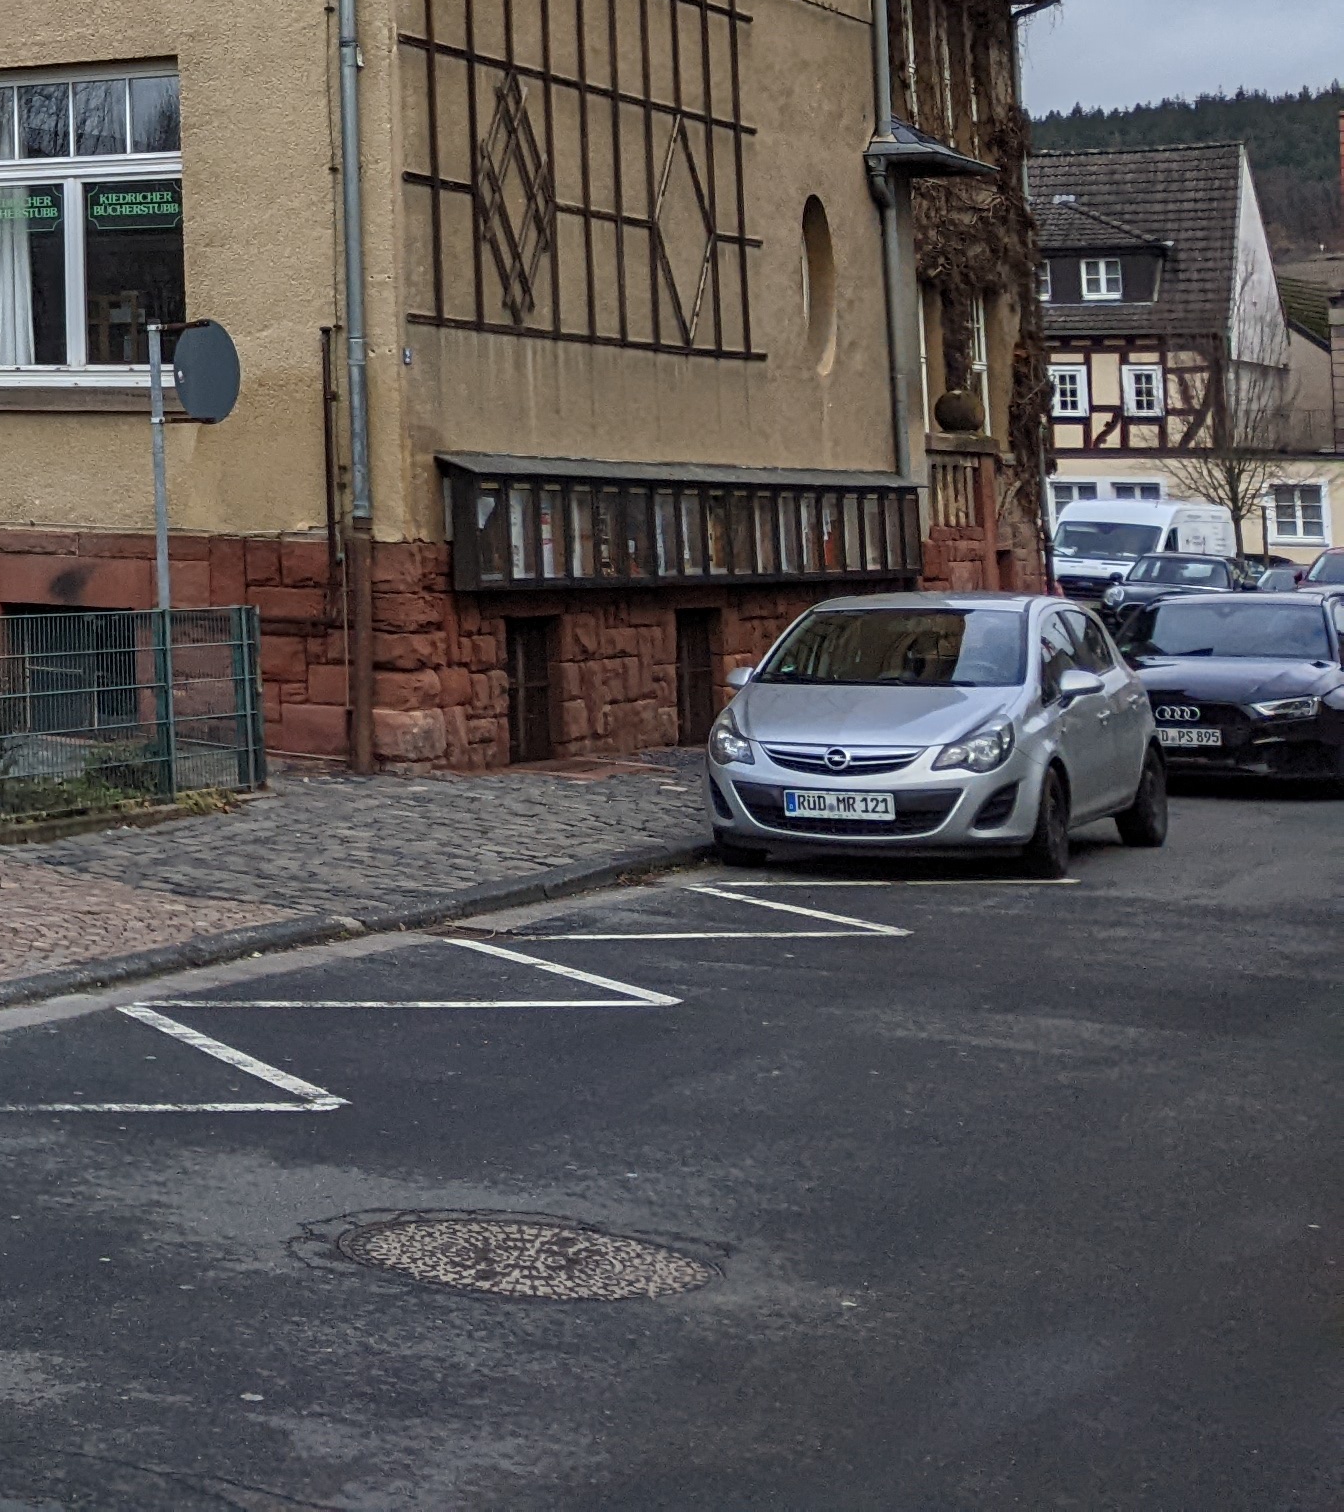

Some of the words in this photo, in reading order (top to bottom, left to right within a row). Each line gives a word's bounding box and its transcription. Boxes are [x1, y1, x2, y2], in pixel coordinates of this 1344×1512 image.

[99, 191, 173, 204] KIEDRICHER
[1178, 730, 1193, 742] PS
[1196, 731, 1219, 743] 895
[797, 794, 826, 811] RÜD
[836, 796, 856, 812] MR
[860, 797, 890, 814] 121
